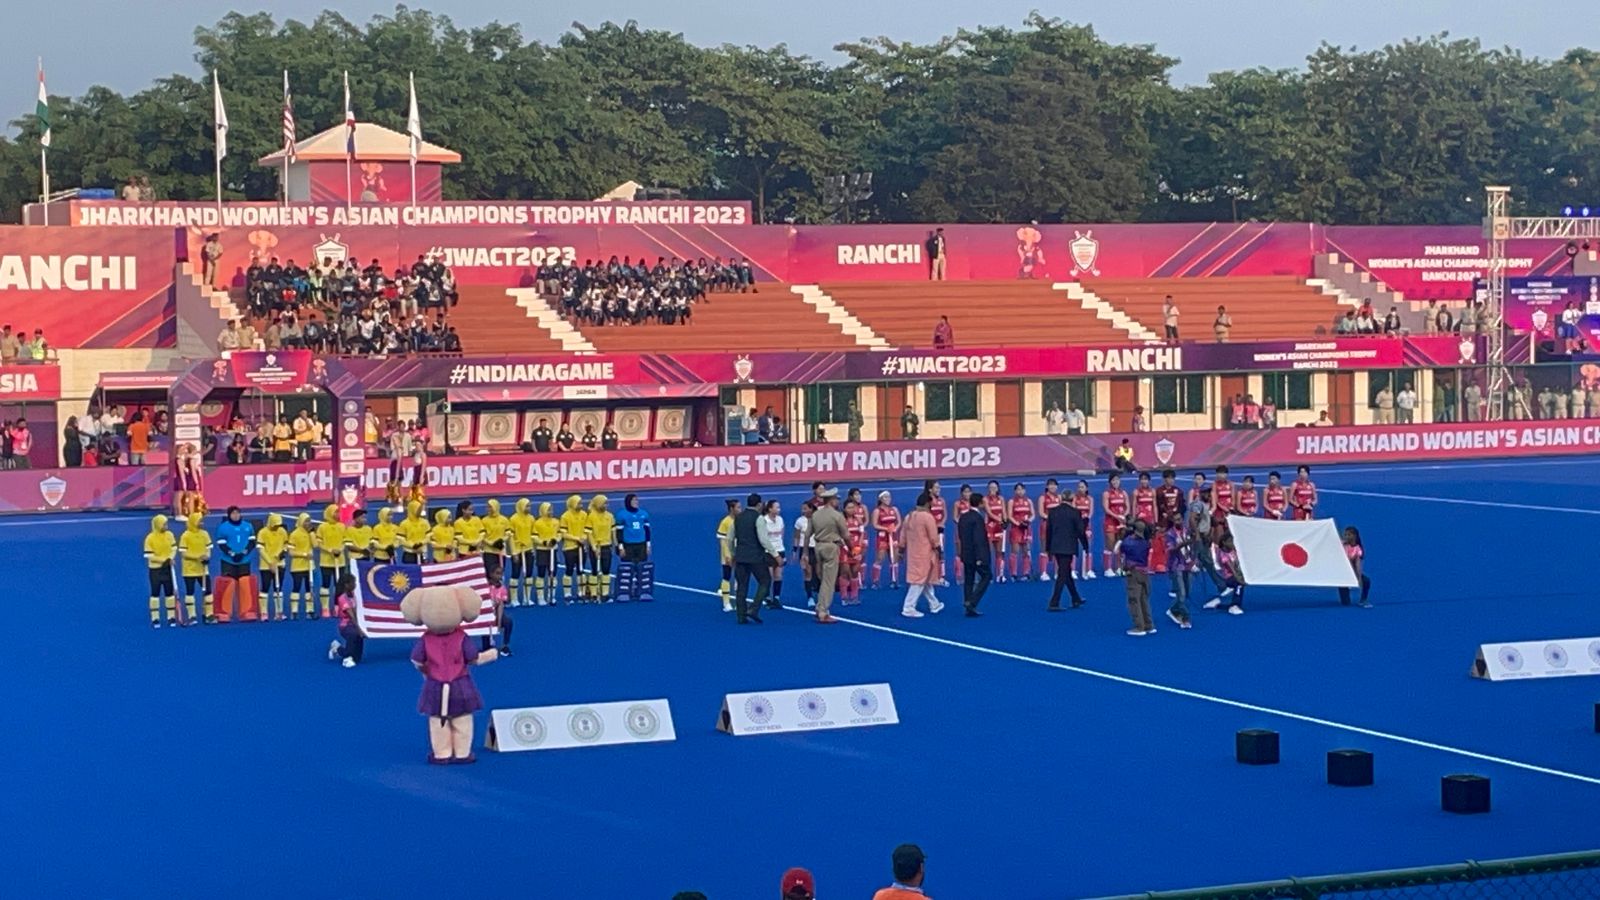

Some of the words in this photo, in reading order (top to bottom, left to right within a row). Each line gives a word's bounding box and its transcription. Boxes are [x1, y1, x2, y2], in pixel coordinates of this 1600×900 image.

[79, 206, 219, 226] JHARKHAND
[222, 206, 329, 226] WOMEN'S
[332, 206, 399, 225] ASIAN
[402, 206, 528, 225] CHAMPIONS
[531, 205, 612, 224] TROPHY
[615, 205, 690, 224] RANCHI
[693, 205, 745, 224] 2023
[424, 246, 576, 267] #JWACT2023
[837, 244, 921, 265] RANCHI
[1424, 245, 1480, 255] JHARKHAND
[1368, 258, 1413, 268] WOMEN'S
[1414, 258, 1442, 268] ASIAN
[1422, 271, 1456, 282] RANCHI
[881, 355, 1006, 374] #JWACT2023
[1087, 348, 1182, 372] RANCHI
[0, 373, 38, 393] SIA
[450, 362, 614, 384] #INDIAKAGAME
[1296, 433, 1420, 454] JHARKHAND
[1422, 429, 1518, 450] WOMEN'S
[1520, 426, 1580, 447] ASIAN
[243, 468, 392, 496] JHARKHND
[525, 460, 602, 483] ASIAN
[607, 454, 751, 480] CHAMPIONS
[755, 451, 848, 474] TROPHY
[852, 448, 937, 470] RANCHI
[941, 446, 1001, 467] 2023
